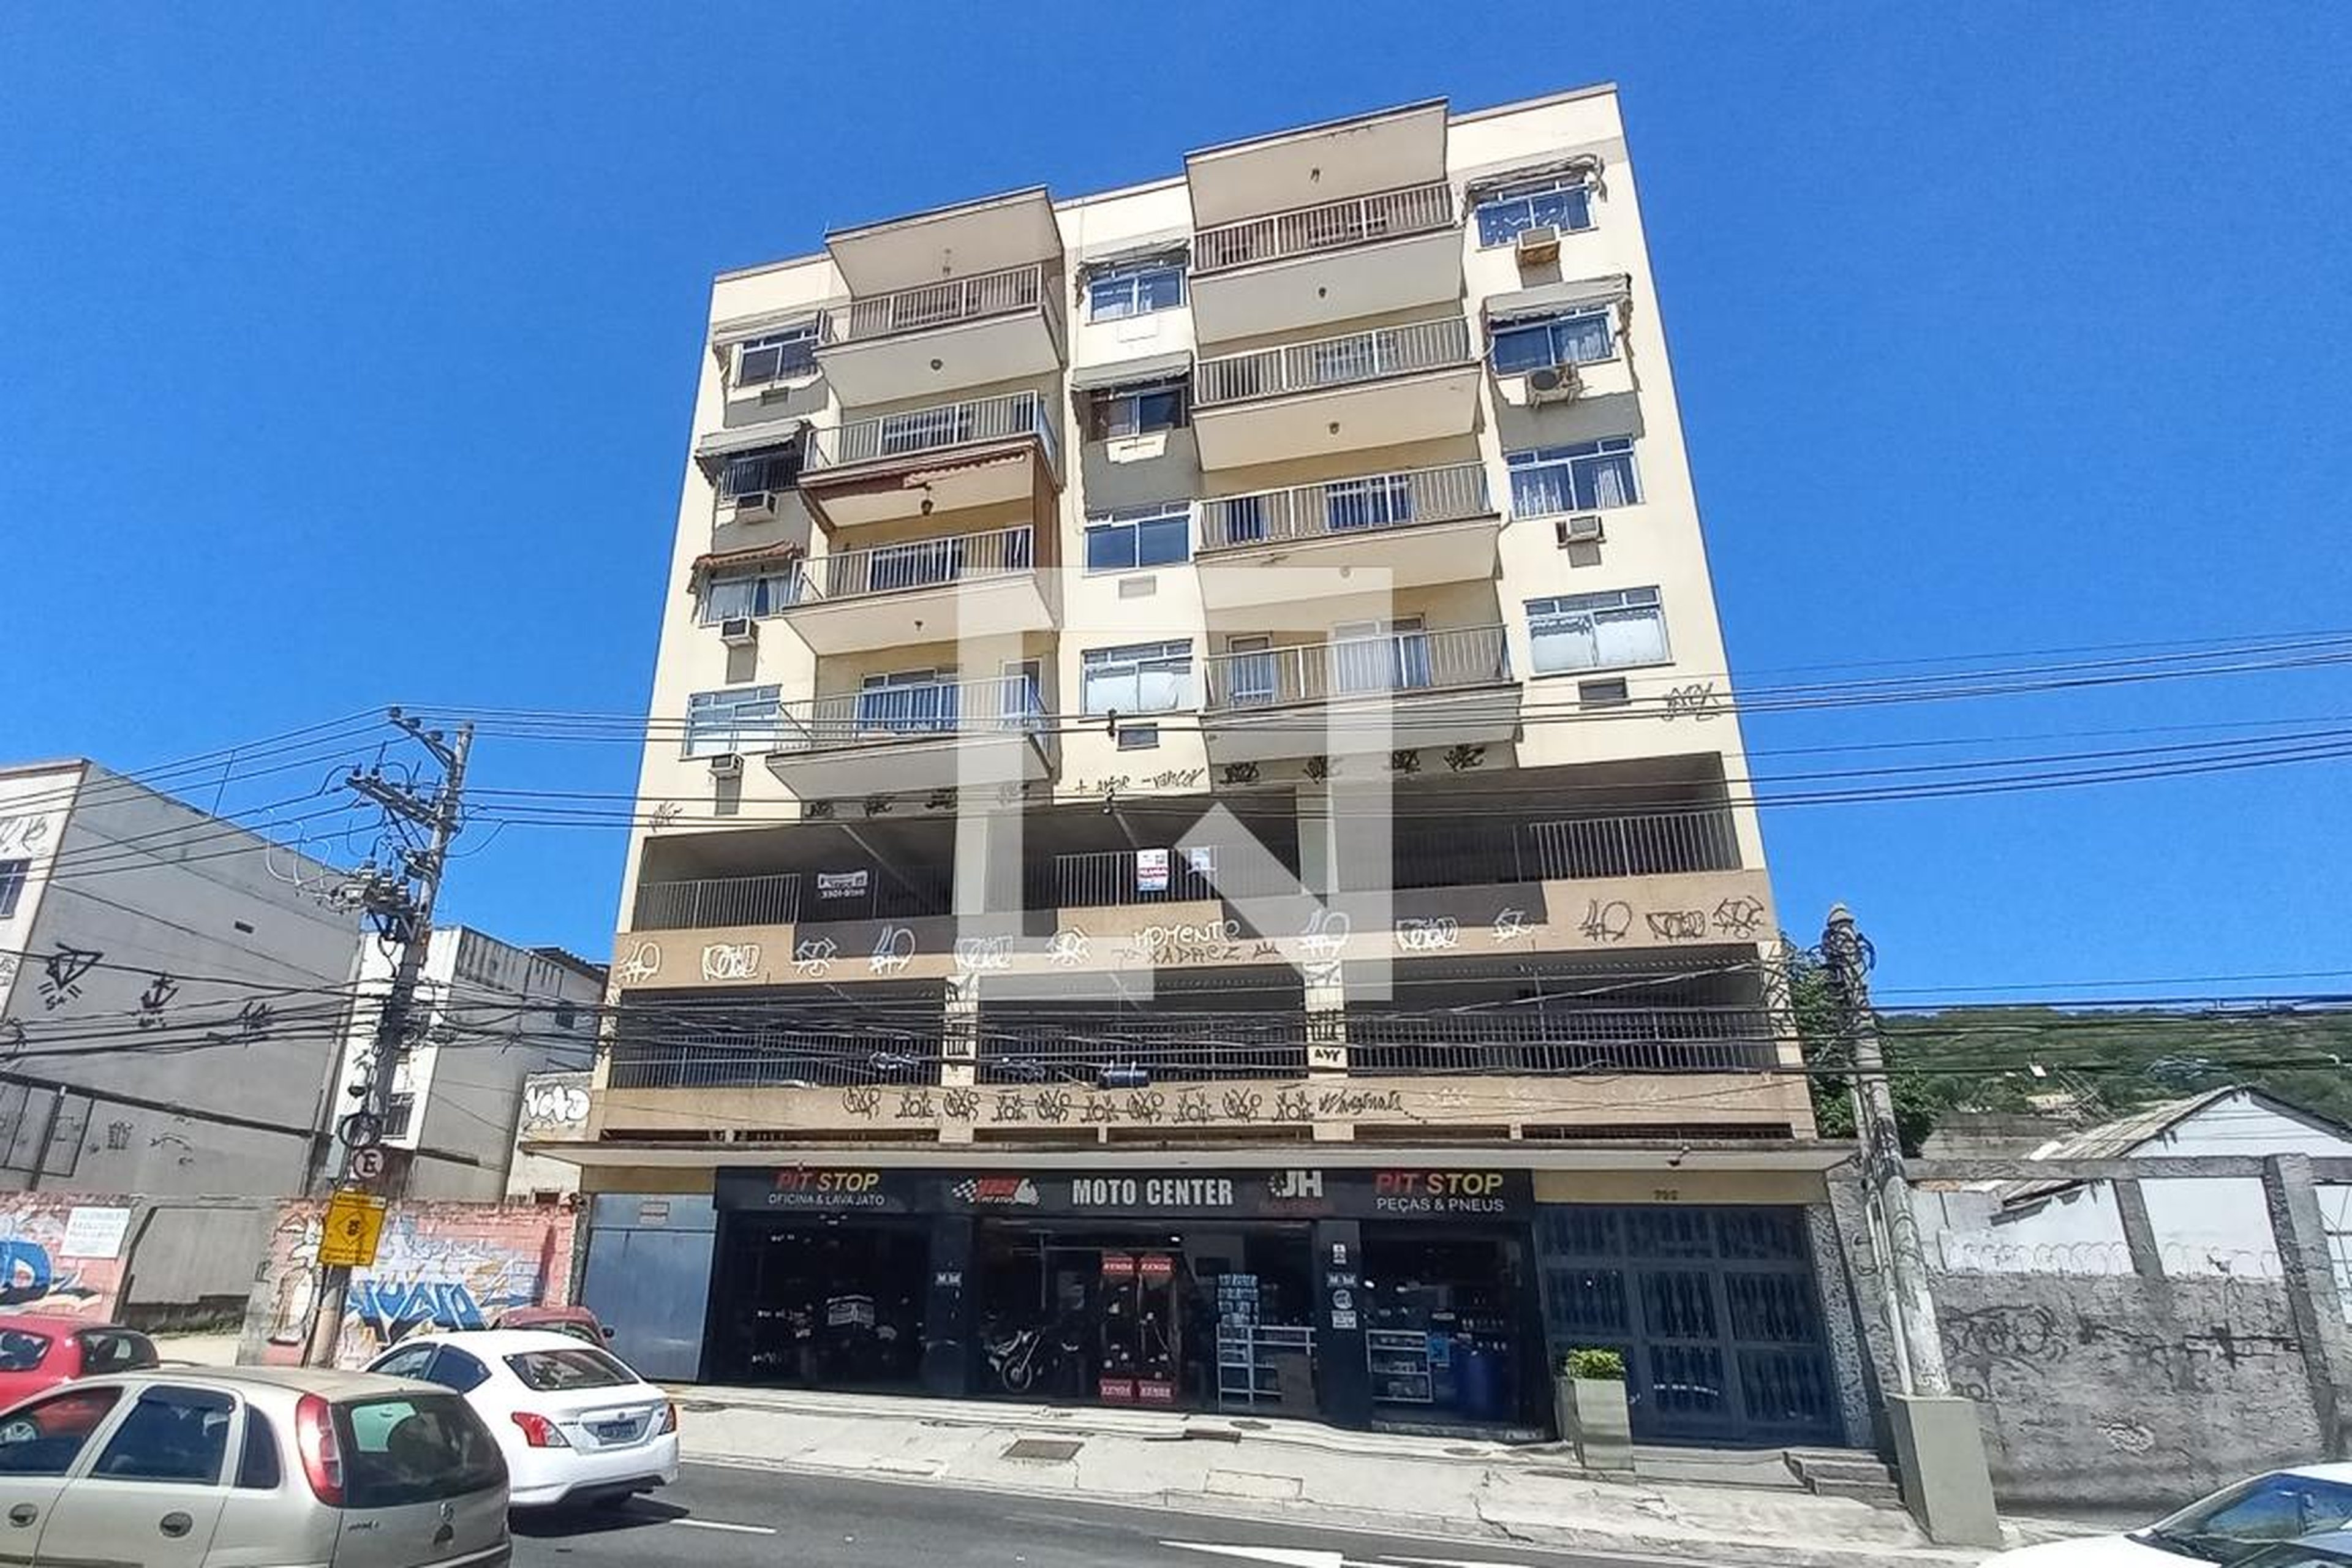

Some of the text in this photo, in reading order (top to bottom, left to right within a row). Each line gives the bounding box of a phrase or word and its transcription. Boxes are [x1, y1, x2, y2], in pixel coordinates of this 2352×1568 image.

[1134, 919, 1241, 947] MOMENTO
[775, 1172, 880, 1192] PIT STOP
[1073, 1178, 1234, 1205] MOTO CENTER
[1281, 1170, 1324, 1197] JH
[1374, 1173, 1504, 1195] PIT STOP
[768, 1194, 814, 1205] OFICINA
[1376, 1197, 1505, 1212] PEÇAS & PNEUS
